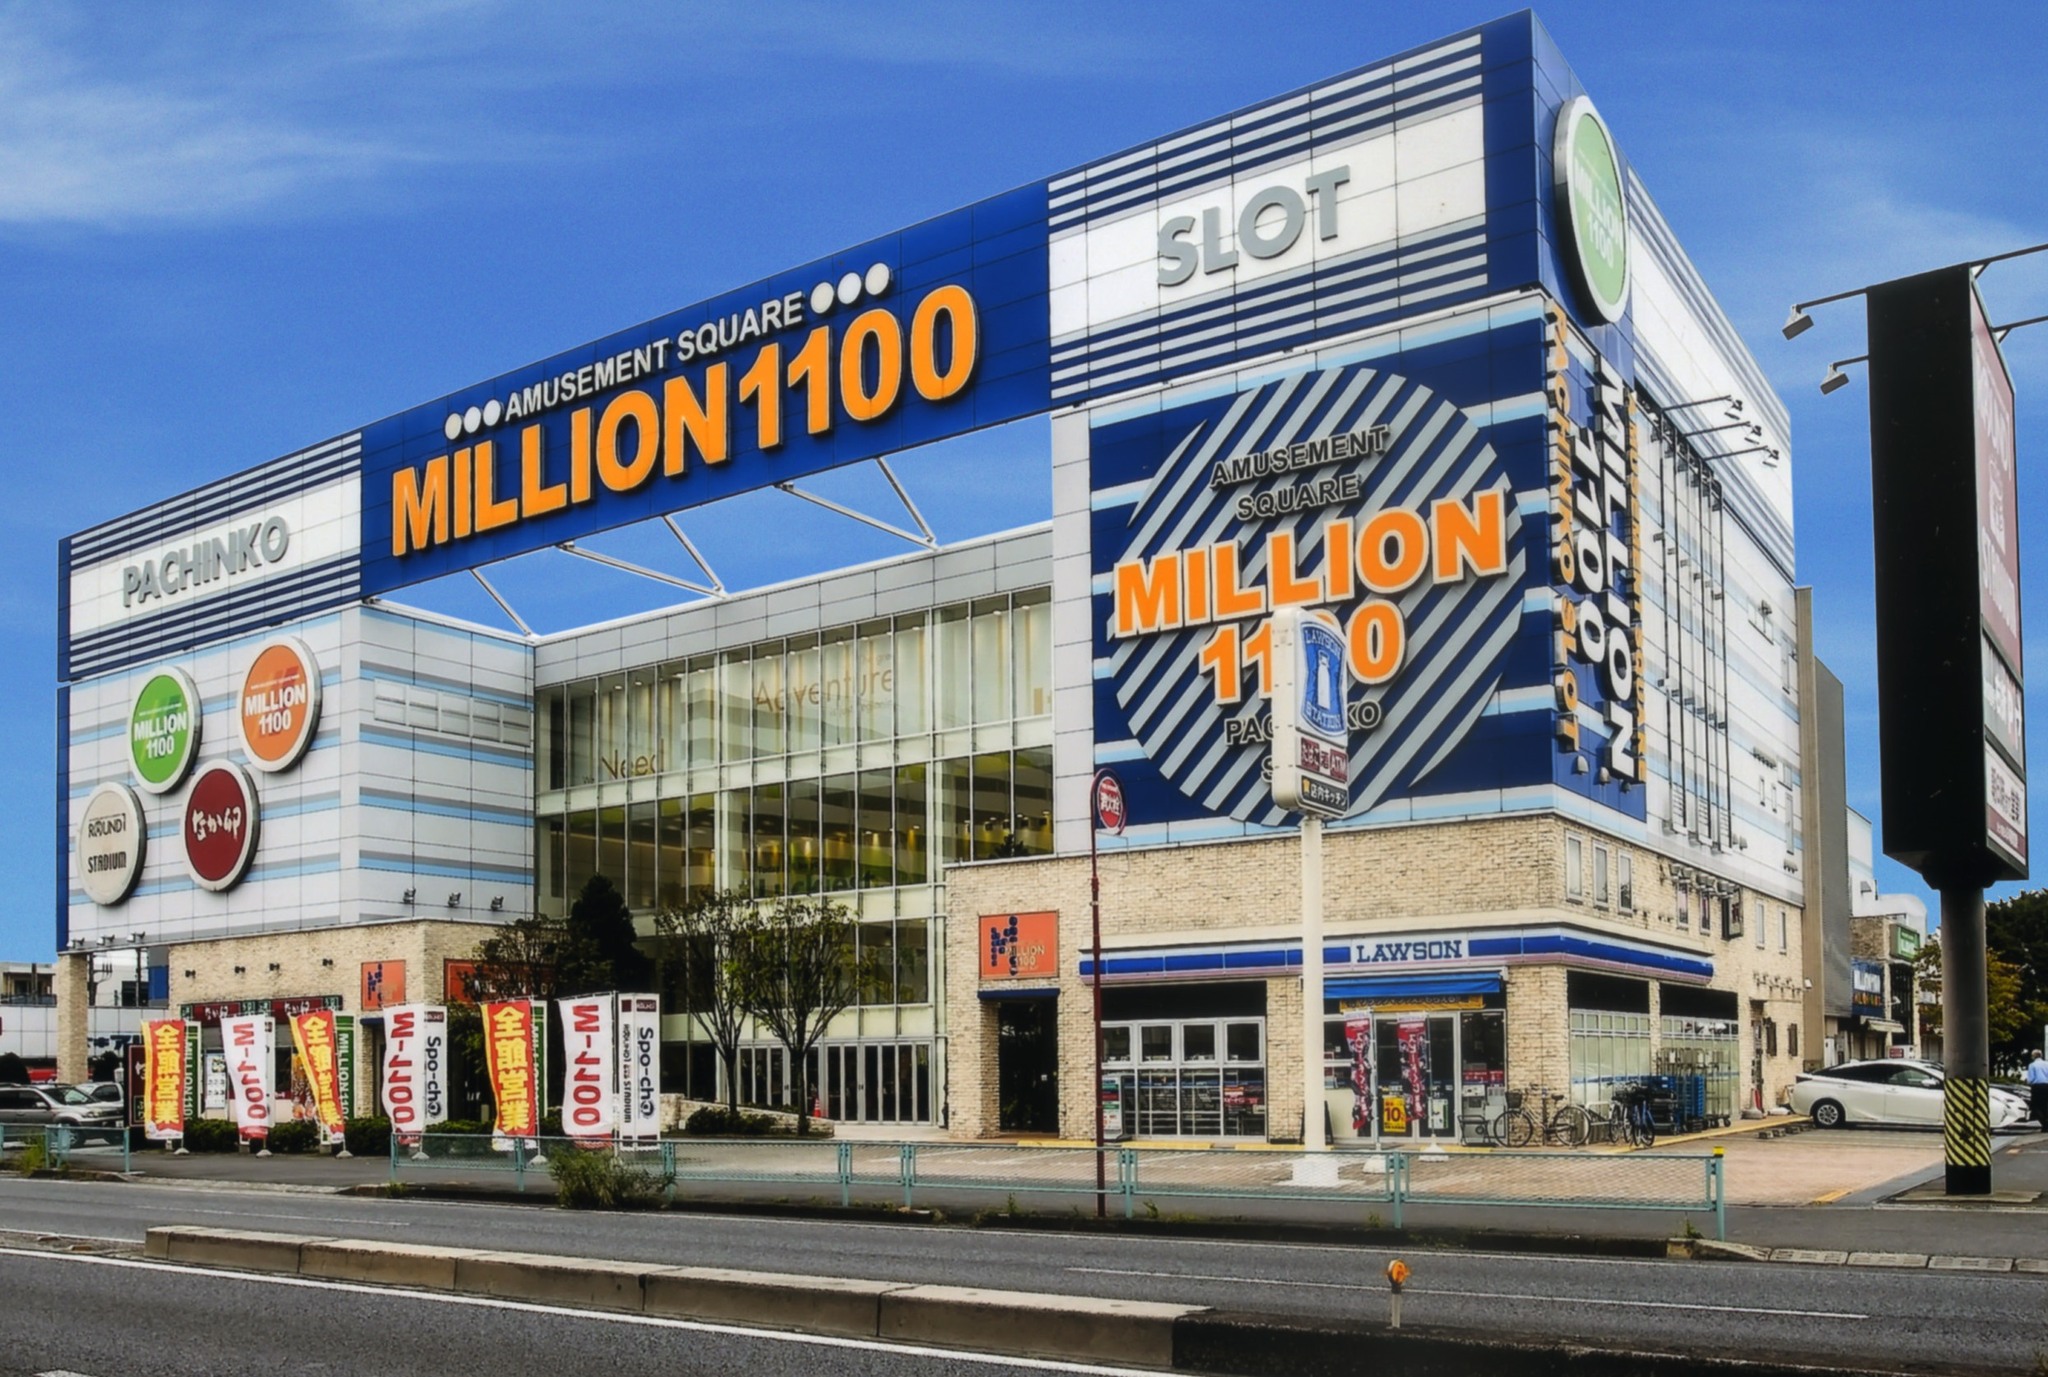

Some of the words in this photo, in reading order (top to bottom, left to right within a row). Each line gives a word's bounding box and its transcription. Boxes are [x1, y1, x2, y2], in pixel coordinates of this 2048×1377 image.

[1158, 165, 1350, 288] SLOT
[1574, 155, 1624, 252] MILLION
[1587, 211, 1614, 270] 1100
[505, 337, 670, 423] AMUSEMENT
[676, 291, 804, 363] SQUARE
[1210, 424, 1391, 490] AMUSEMENT
[1549, 298, 1576, 585] PACHINKO
[1236, 473, 1361, 521] SQUARE
[123, 515, 290, 608] PACHINKO
[1112, 488, 1509, 640] MILLION
[1574, 426, 1606, 664] 1100
[1600, 353, 1636, 780] MILLION
[1200, 598, 1407, 705] 110
[1556, 592, 1580, 752] SLOT
[133, 711, 187, 741] MILLION
[245, 683, 306, 717] MILLION
[259, 709, 292, 736] 1100
[1224, 698, 1382, 746] PAKO
[146, 735, 175, 759] 1100
[87, 851, 127, 874] STADIUM
[1356, 940, 1463, 963] LAWSON
